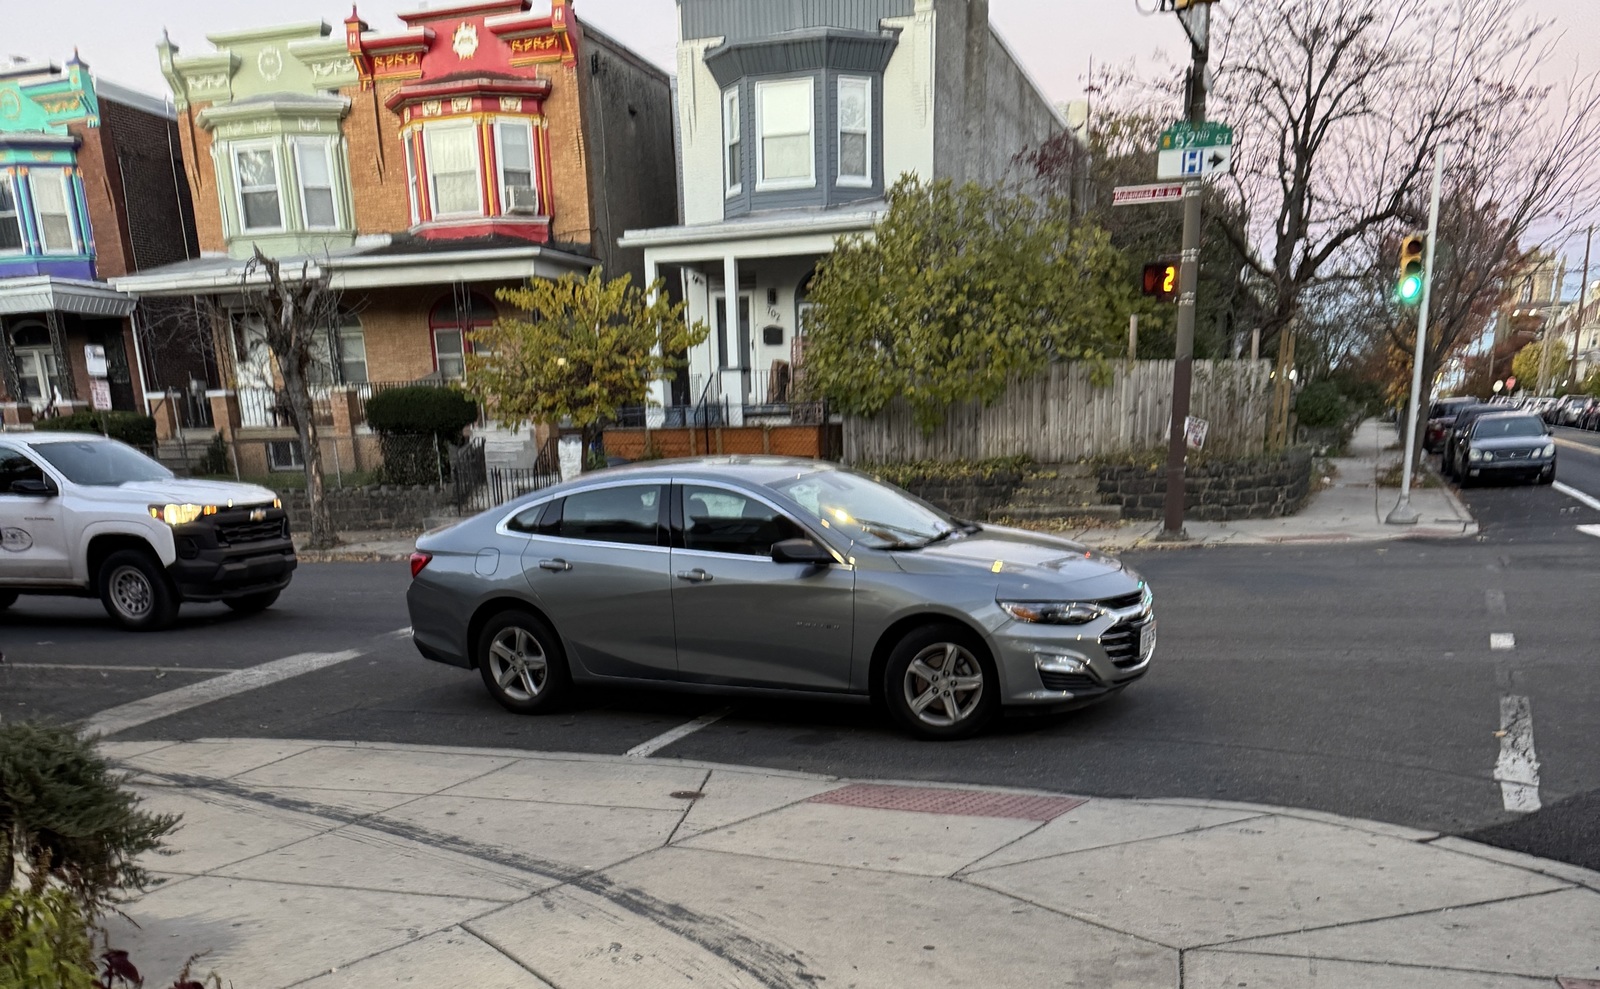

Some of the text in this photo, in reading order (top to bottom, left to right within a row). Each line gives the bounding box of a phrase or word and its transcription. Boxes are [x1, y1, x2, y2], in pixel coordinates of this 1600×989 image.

[1215, 132, 1230, 145] ST
[1184, 151, 1202, 175] H
[1163, 266, 1175, 292] 2
